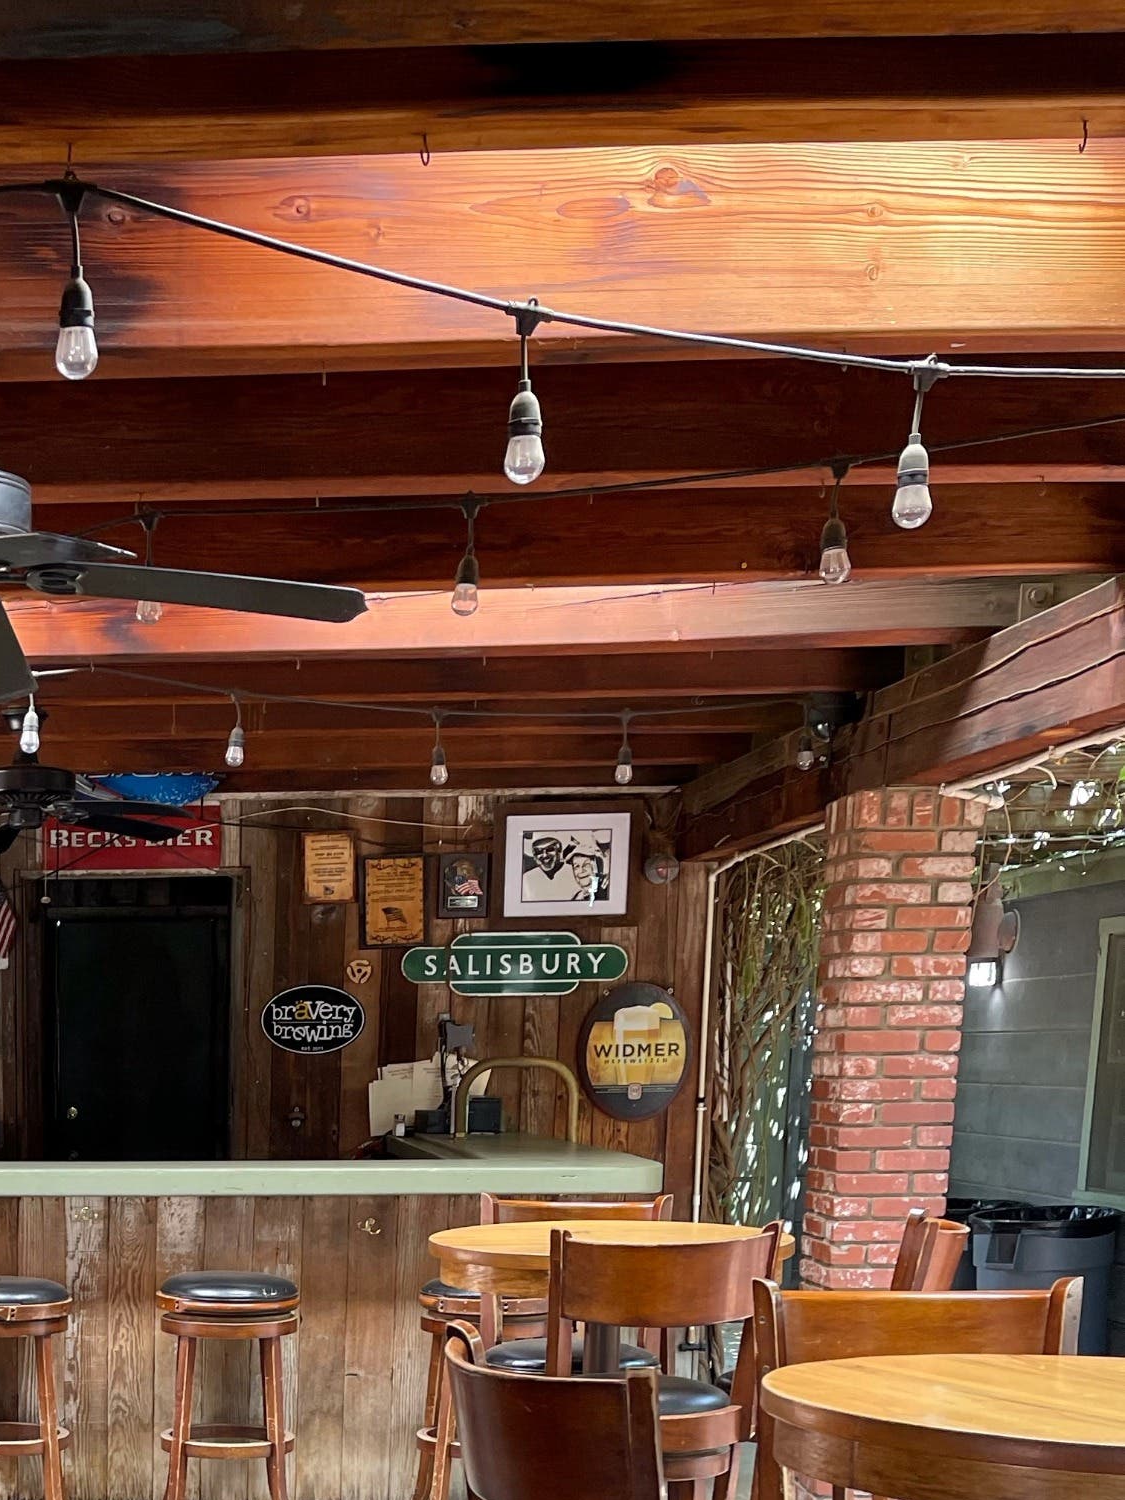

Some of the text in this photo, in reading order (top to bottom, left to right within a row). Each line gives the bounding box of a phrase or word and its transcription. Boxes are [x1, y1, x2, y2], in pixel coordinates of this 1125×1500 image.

[424, 952, 607, 976] SALISBURY
[271, 1020, 354, 1042] brewing
[593, 1043, 680, 1058] WIDMER
